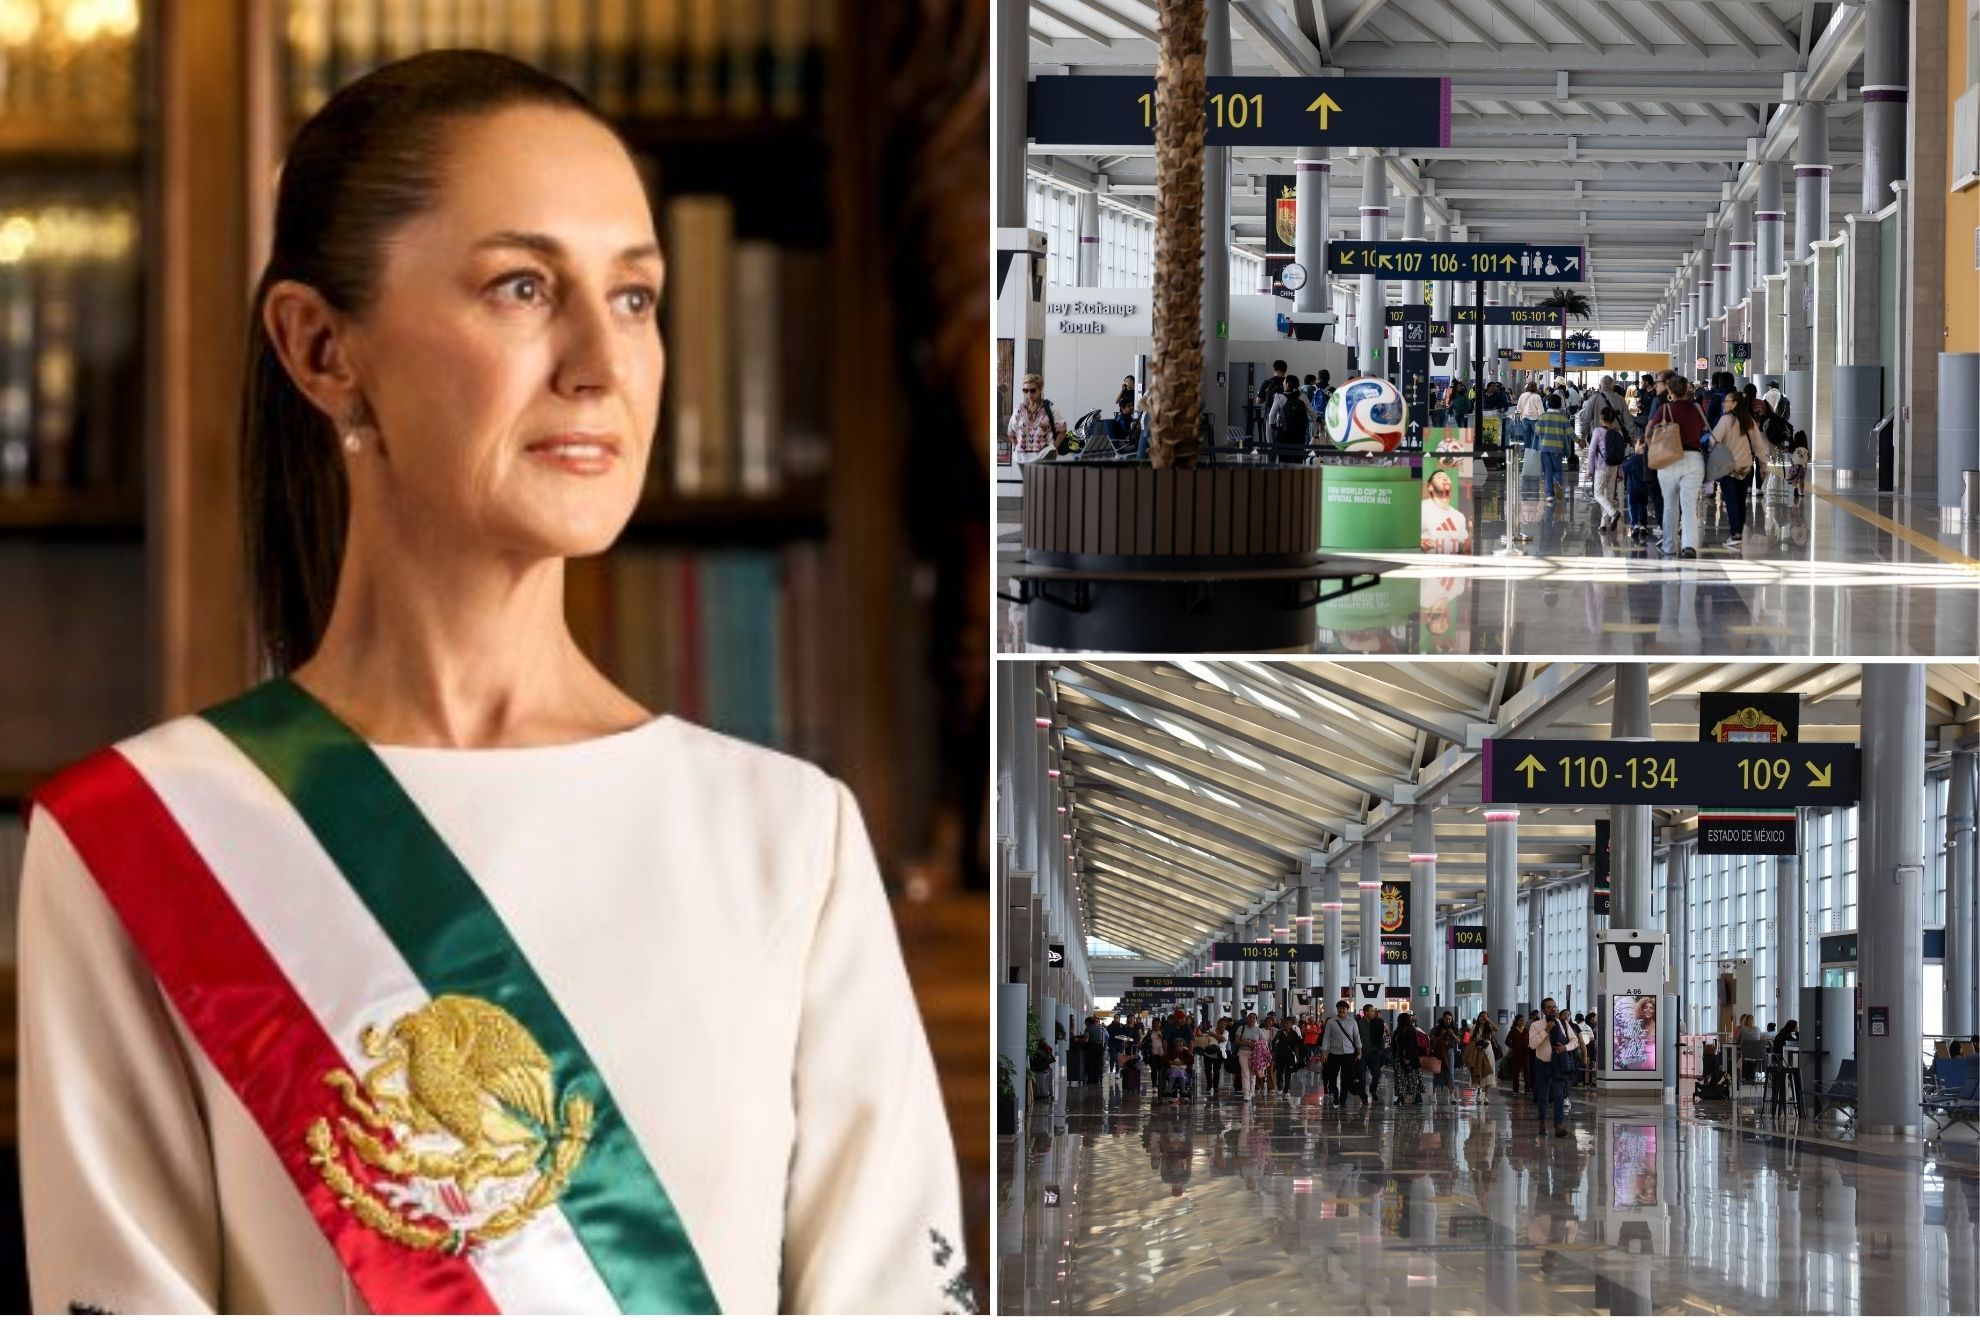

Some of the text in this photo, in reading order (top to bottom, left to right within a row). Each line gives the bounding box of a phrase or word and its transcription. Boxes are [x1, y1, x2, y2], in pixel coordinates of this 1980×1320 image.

[1394, 253, 1423, 272] 107
[1047, 301, 1136, 317] ney Exchange
[1390, 311, 1404, 321] 107
[1511, 311, 1546, 321] 105-101
[1059, 320, 1104, 334] Cocula
[1430, 325, 1438, 334] 07
[1340, 487, 1362, 495] WORLD
[1364, 488, 1377, 496] CUP
[1354, 496, 1376, 504] MATCH
[1558, 756, 1791, 790] 110-134 109
[1708, 827, 1785, 842] ESTADO DE MÉXICO
[1456, 932, 1483, 943] 109 A
[1243, 947, 1279, 957] 110-134
[1386, 950, 1408, 960] 109 B
